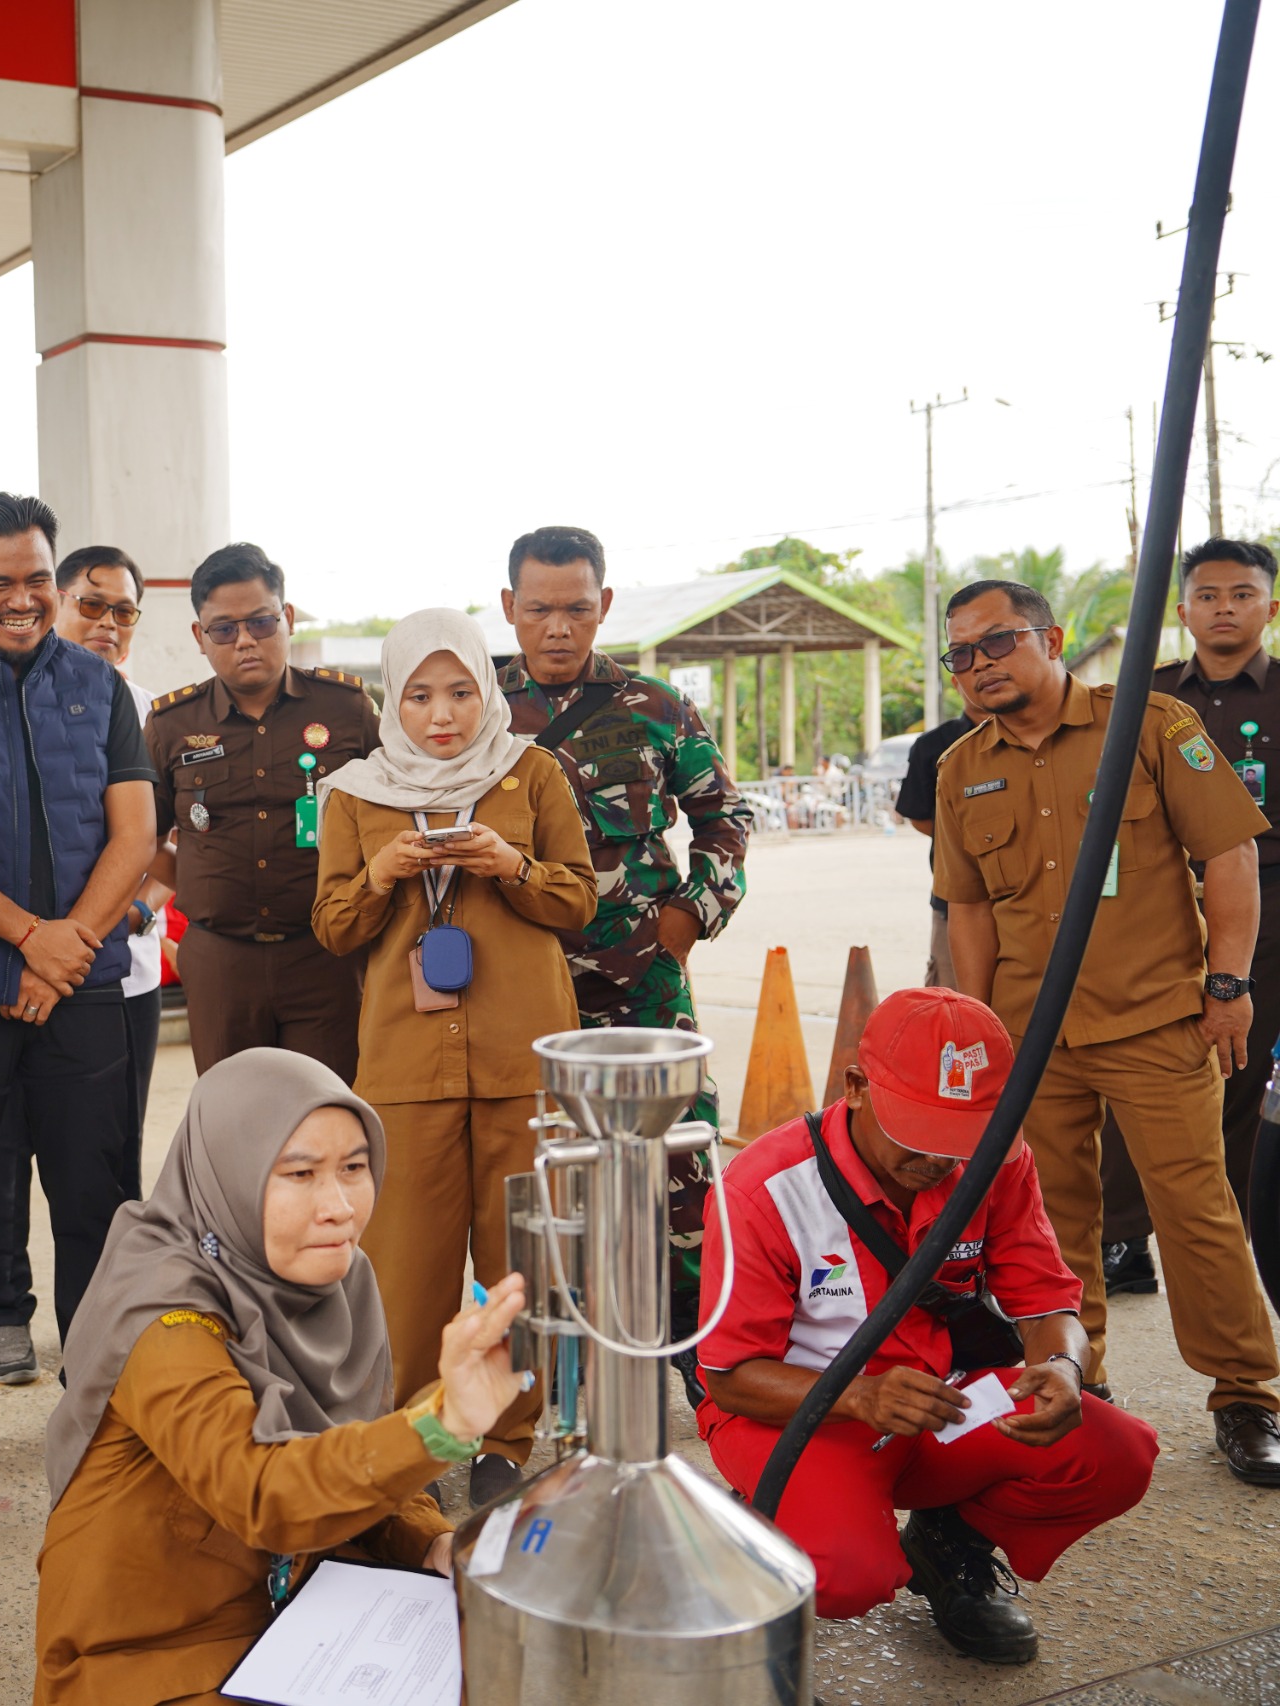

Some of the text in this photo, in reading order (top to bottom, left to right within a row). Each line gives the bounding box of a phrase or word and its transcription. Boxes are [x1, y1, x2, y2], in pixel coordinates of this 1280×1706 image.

[581, 730, 640, 753] TNI AD
[809, 1286, 854, 1299] PERTAMINA
